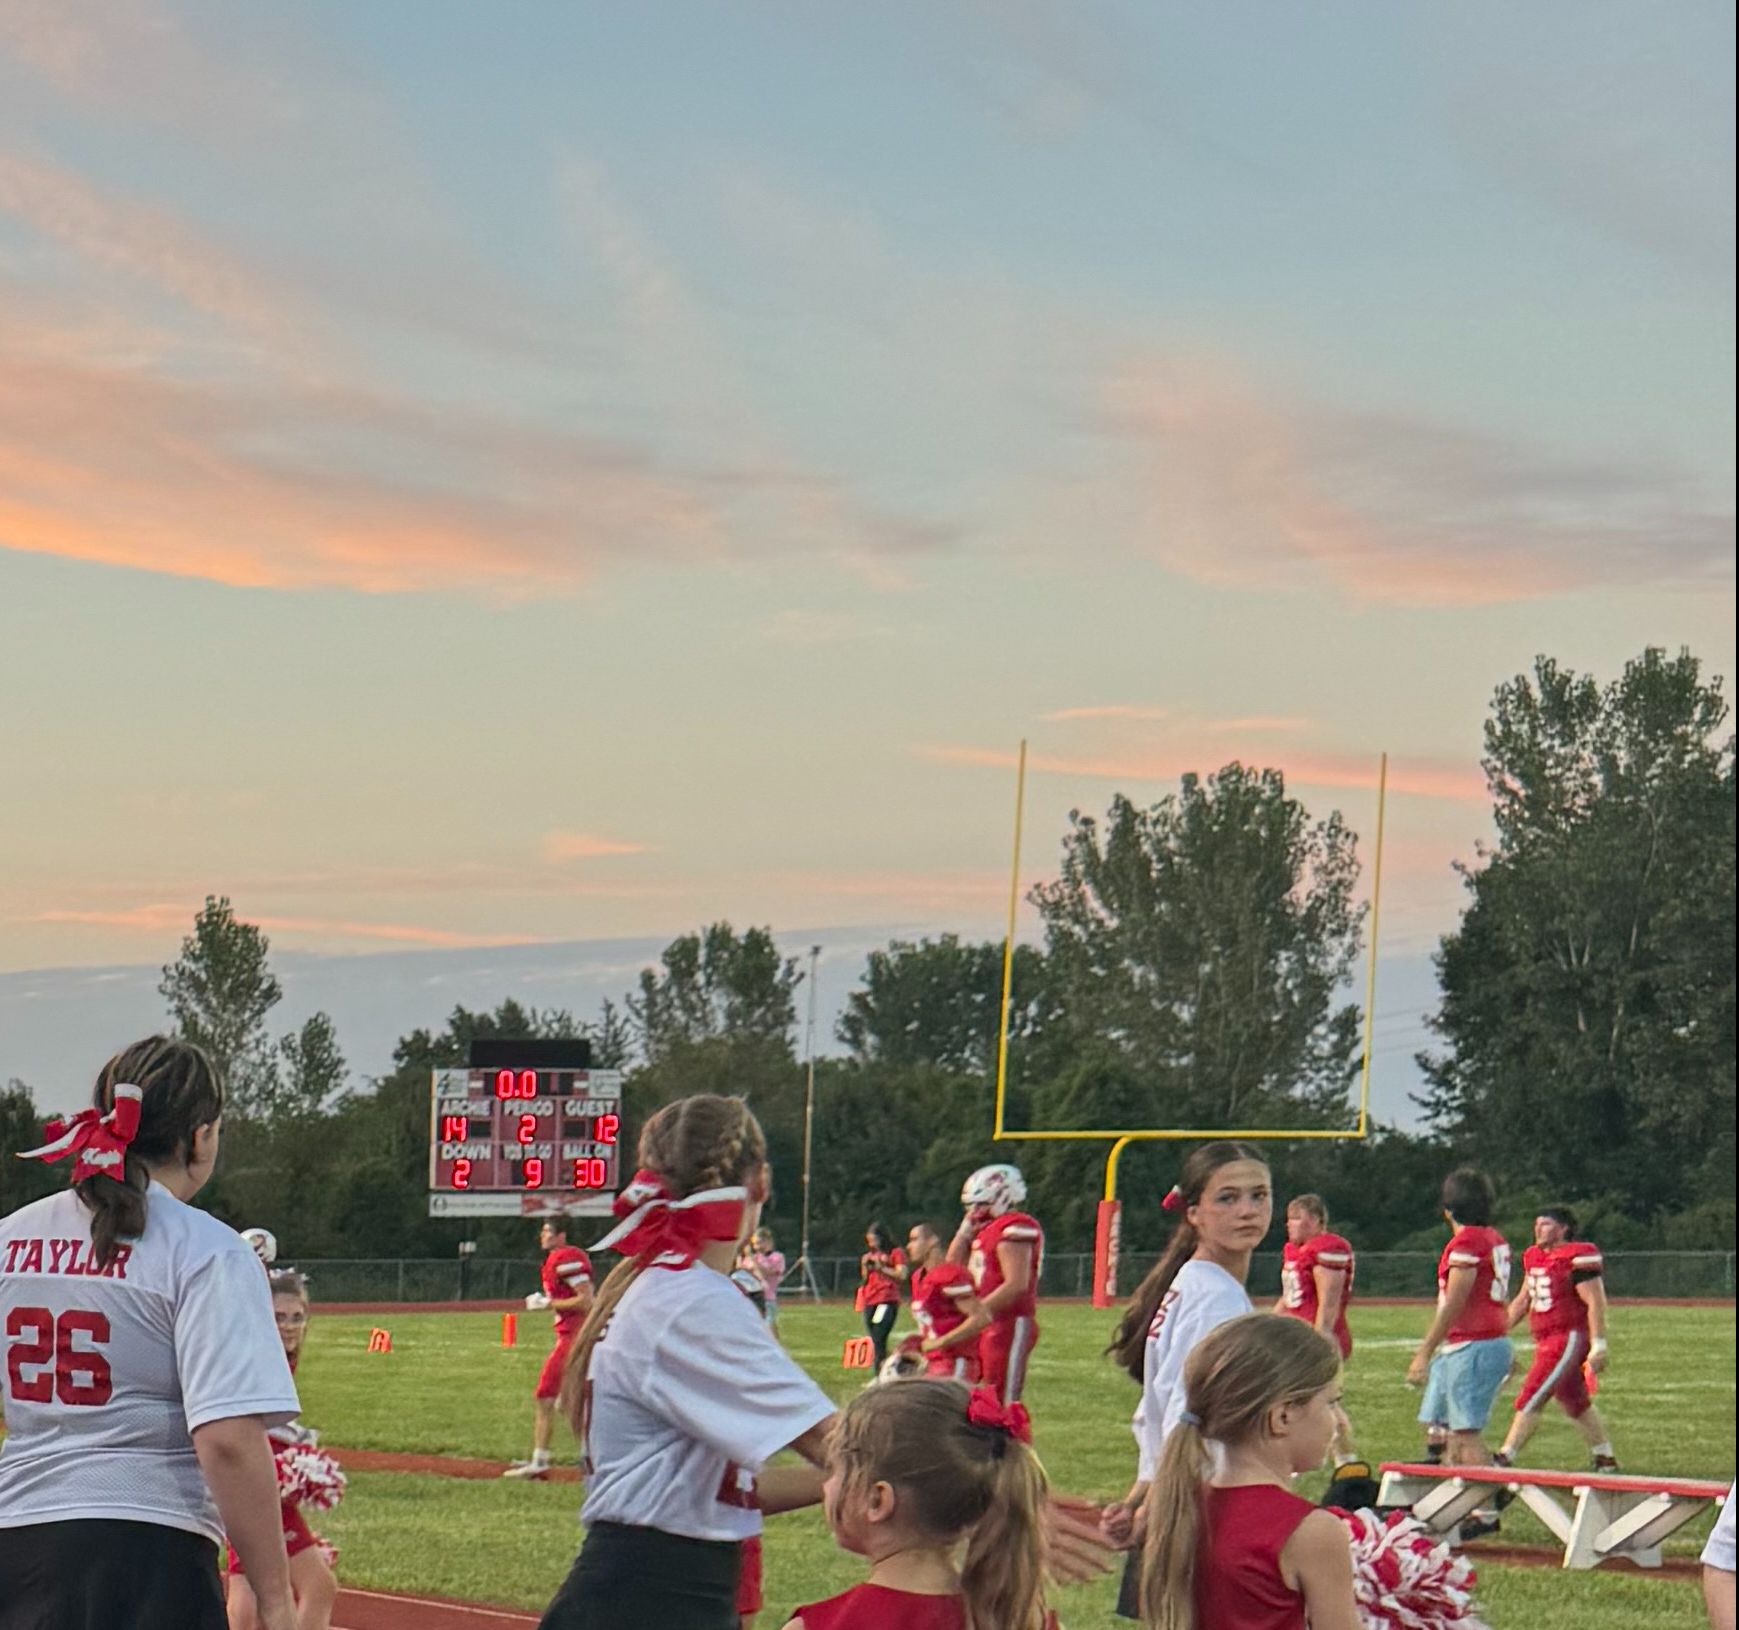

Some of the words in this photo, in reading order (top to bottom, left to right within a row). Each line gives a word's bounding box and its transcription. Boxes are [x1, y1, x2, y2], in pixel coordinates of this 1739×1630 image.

[497, 1070, 537, 1098] 0.0
[441, 1101, 491, 1116] ARCHIE
[566, 1101, 614, 1116] GUEST
[444, 1116, 467, 1142] 14
[520, 1115, 536, 1143] 2
[596, 1115, 619, 1143] 12
[442, 1144, 491, 1160] DOWN
[563, 1144, 592, 1160] BALL
[453, 1159, 470, 1187] 2
[525, 1159, 542, 1187] 9
[575, 1158, 607, 1188] 30
[6, 1306, 113, 1406] 26
[850, 1341, 868, 1365] 10
